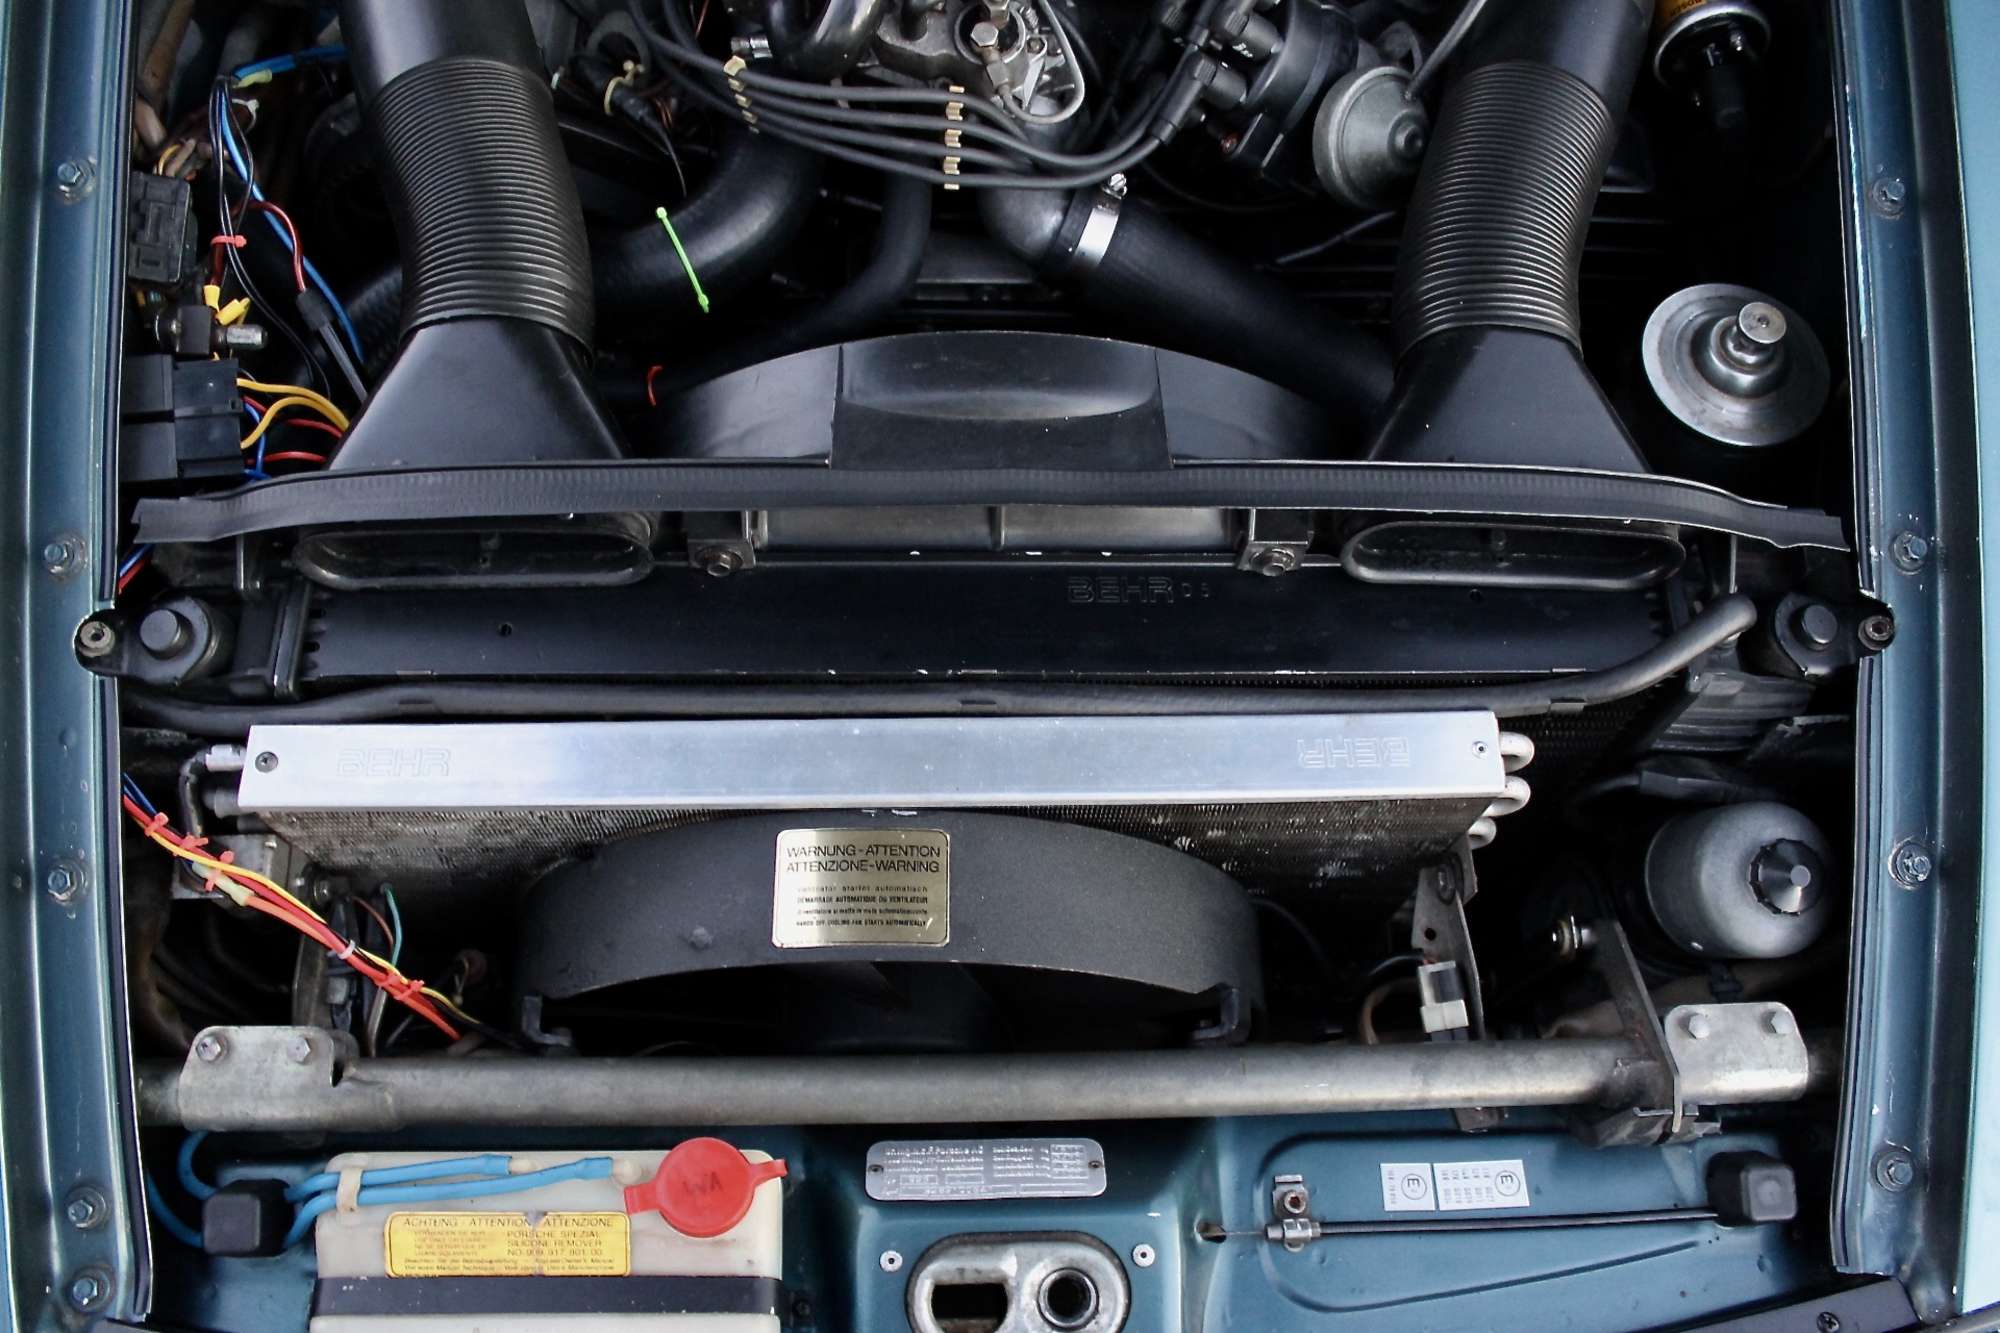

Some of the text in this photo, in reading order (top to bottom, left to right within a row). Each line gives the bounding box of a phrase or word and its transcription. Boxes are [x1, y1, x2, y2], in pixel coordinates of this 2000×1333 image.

[1067, 576, 1174, 603] BEHR
[336, 746, 452, 777] BEHR
[404, 1217, 458, 1227] ACHTUNG
[543, 1217, 614, 1227] ATTENZIONE
